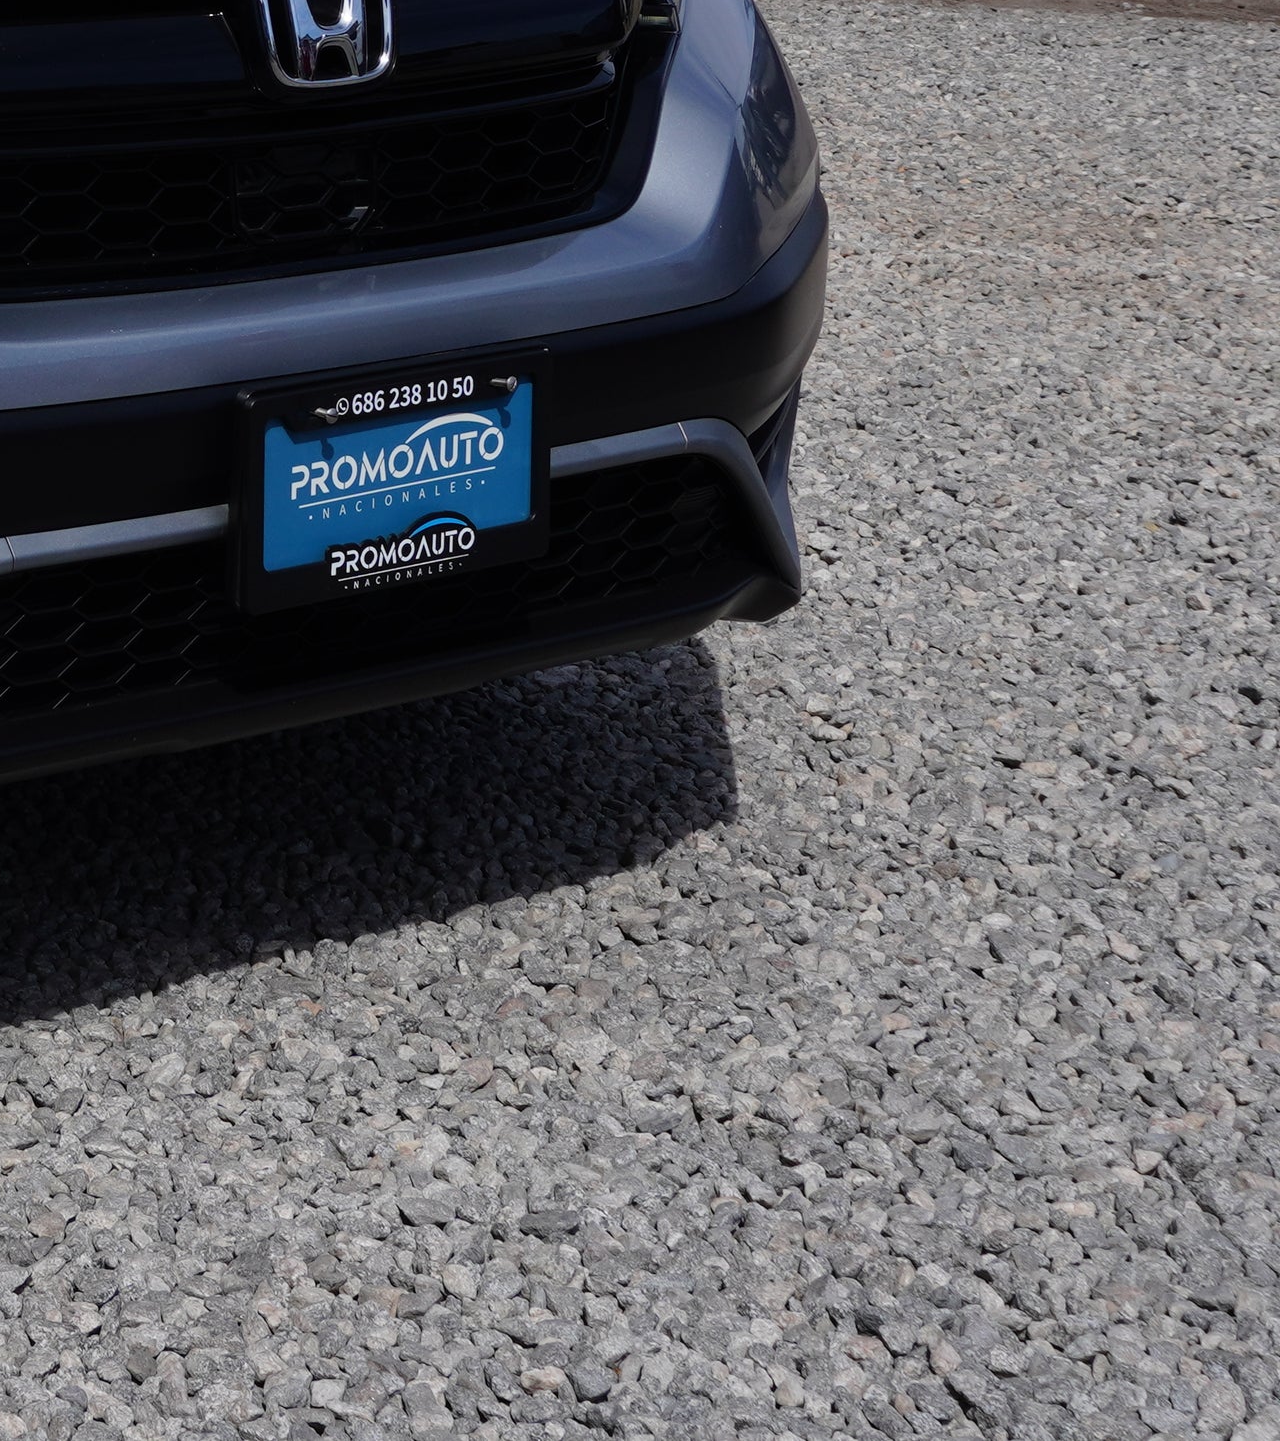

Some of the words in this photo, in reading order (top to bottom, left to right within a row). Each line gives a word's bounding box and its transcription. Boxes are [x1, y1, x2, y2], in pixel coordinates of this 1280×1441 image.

[352, 390, 385, 415] 686
[389, 384, 422, 409] 238
[426, 380, 448, 403] 10
[452, 375, 474, 398] 50
[291, 426, 504, 501] PROMOAUTO
[321, 478, 473, 520] NACIONALES
[330, 526, 476, 577] PROMOAUTO
[352, 560, 455, 590] NACIONALES
